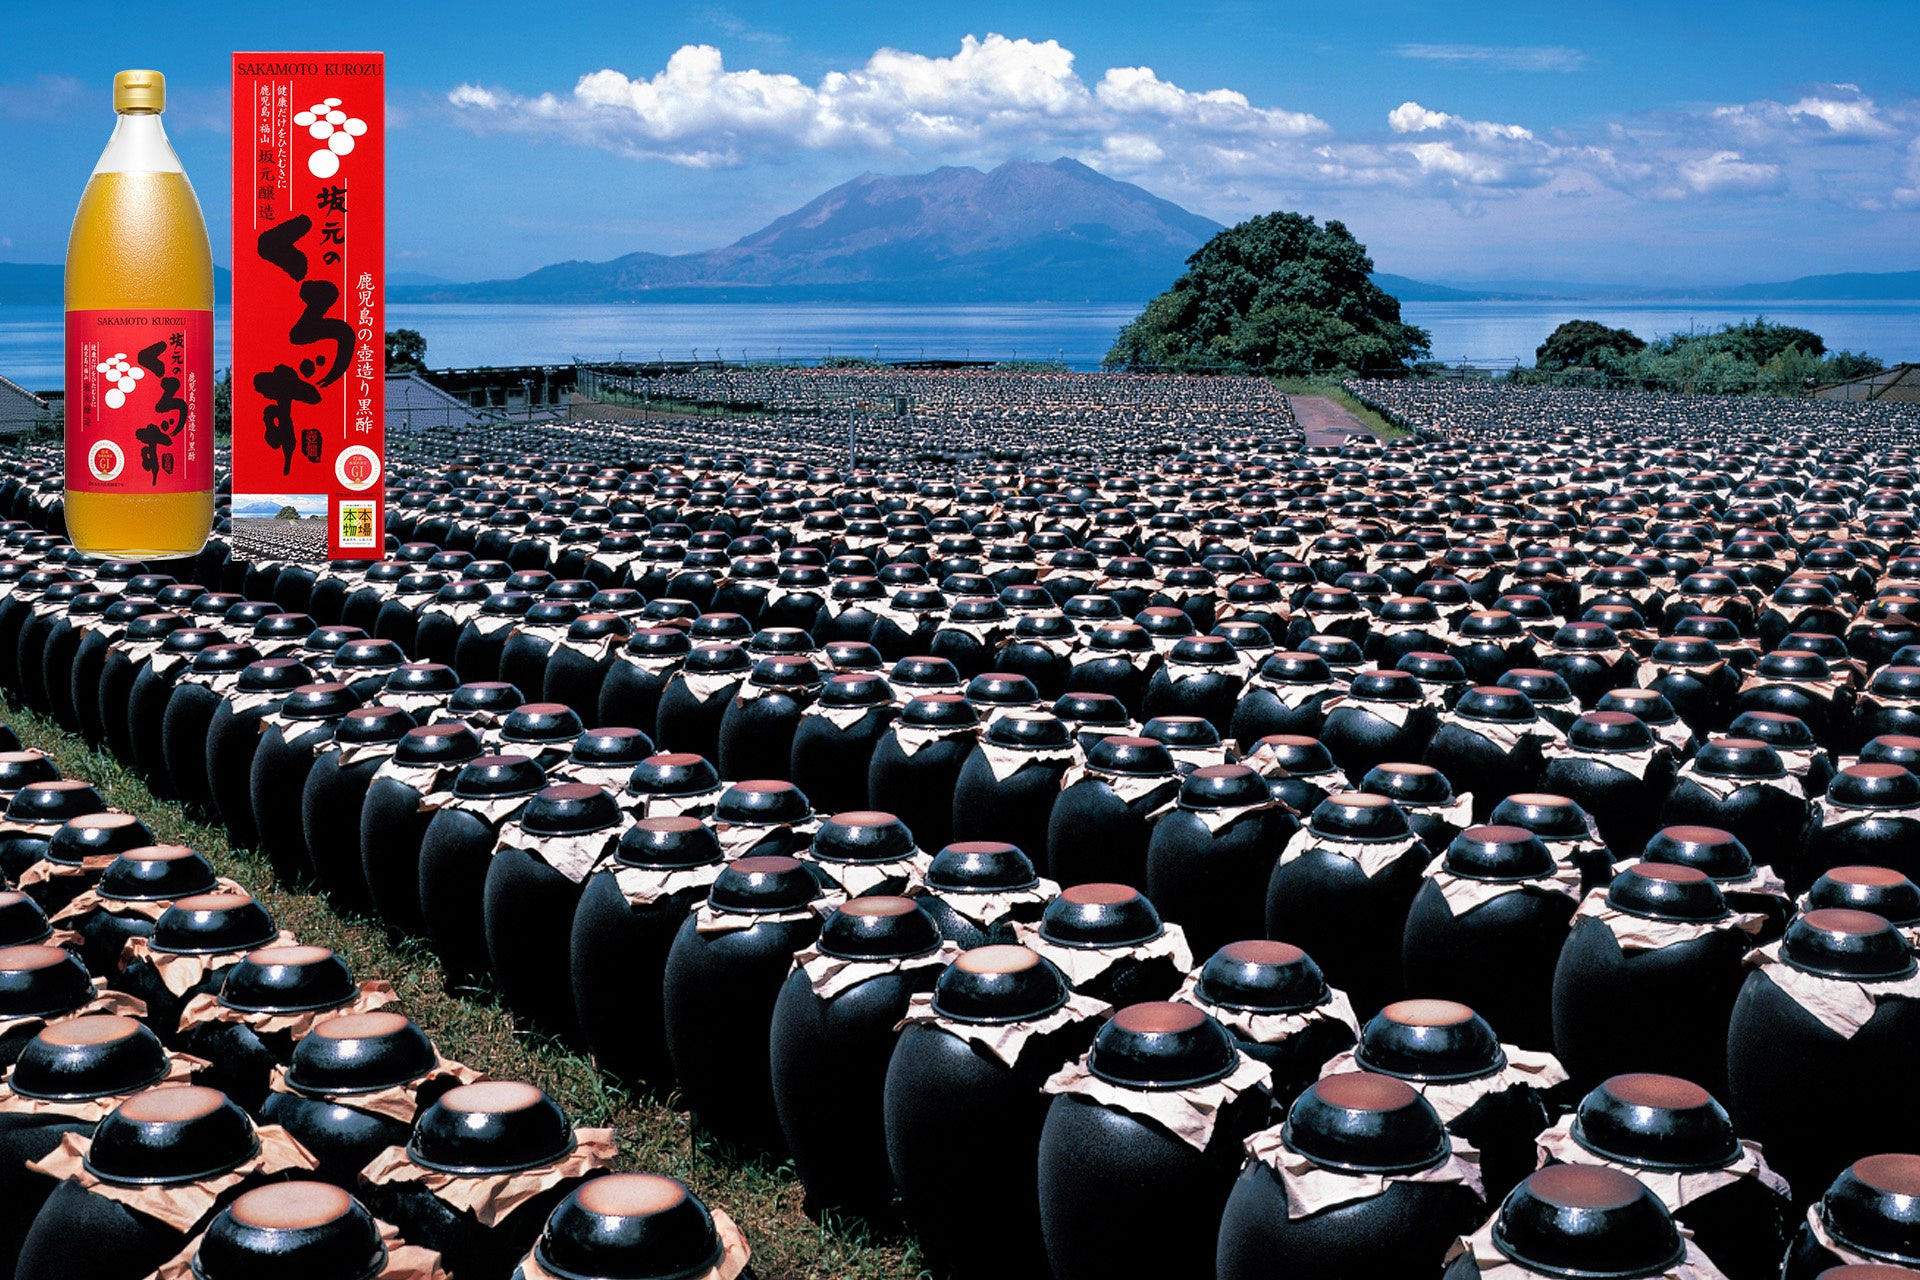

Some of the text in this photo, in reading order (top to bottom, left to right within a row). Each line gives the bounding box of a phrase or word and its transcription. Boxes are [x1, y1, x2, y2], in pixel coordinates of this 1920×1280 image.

[237, 63, 382, 76] SAKAMOTO KUROZU
[258, 84, 276, 221] 鹿児島・福山 坂元醸造
[277, 85, 288, 189] 健康だけをひたむきに
[316, 186, 348, 266] 坂元の
[97, 317, 186, 326] SAKAMOTO KUROZU
[169, 332, 184, 375] 坂元の
[254, 214, 356, 476] くろず
[355, 272, 375, 434] 鹿児島の壺造り黒酢
[351, 465, 364, 478] GI
